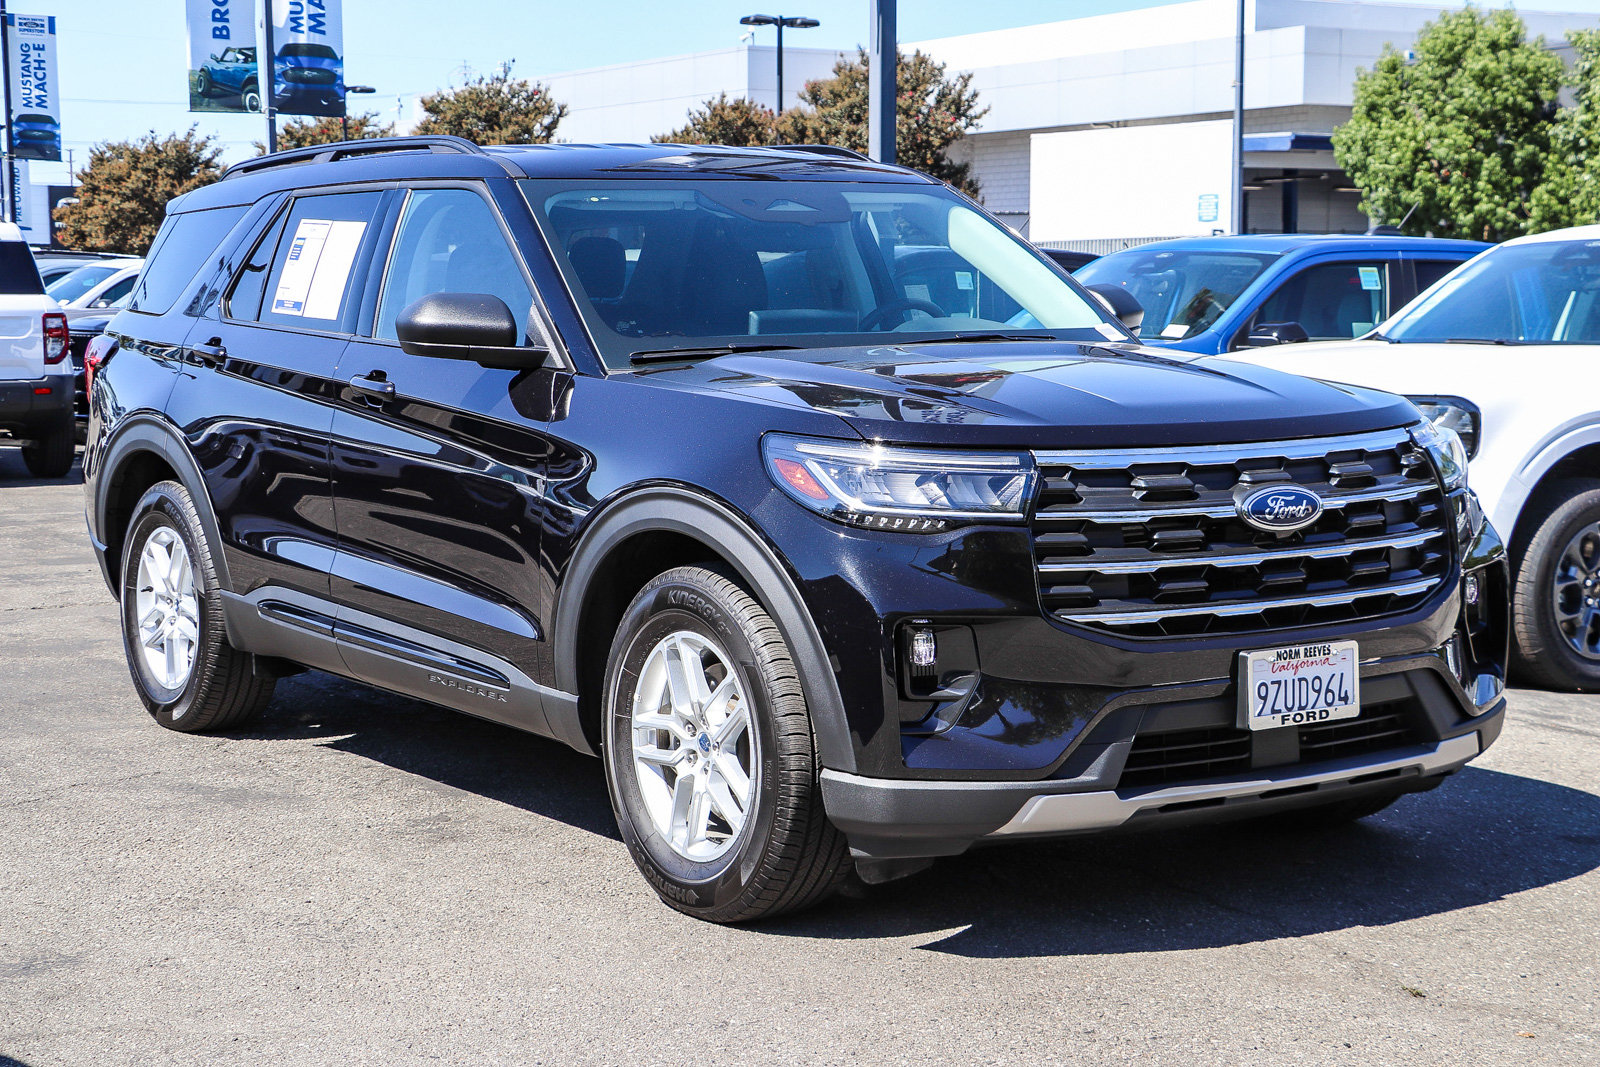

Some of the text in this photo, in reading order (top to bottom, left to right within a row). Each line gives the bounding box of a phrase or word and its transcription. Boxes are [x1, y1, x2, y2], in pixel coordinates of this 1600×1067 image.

[20, 42, 33, 108] MUSTANG
[32, 43, 48, 109] MACH-E
[1263, 495, 1312, 520] Ford
[1271, 657, 1337, 676] California
[1276, 644, 1331, 662] NORM REEVES
[427, 673, 508, 703] EXPLORER
[1256, 672, 1350, 717] 9ZUD964
[1281, 709, 1330, 725] FORD
